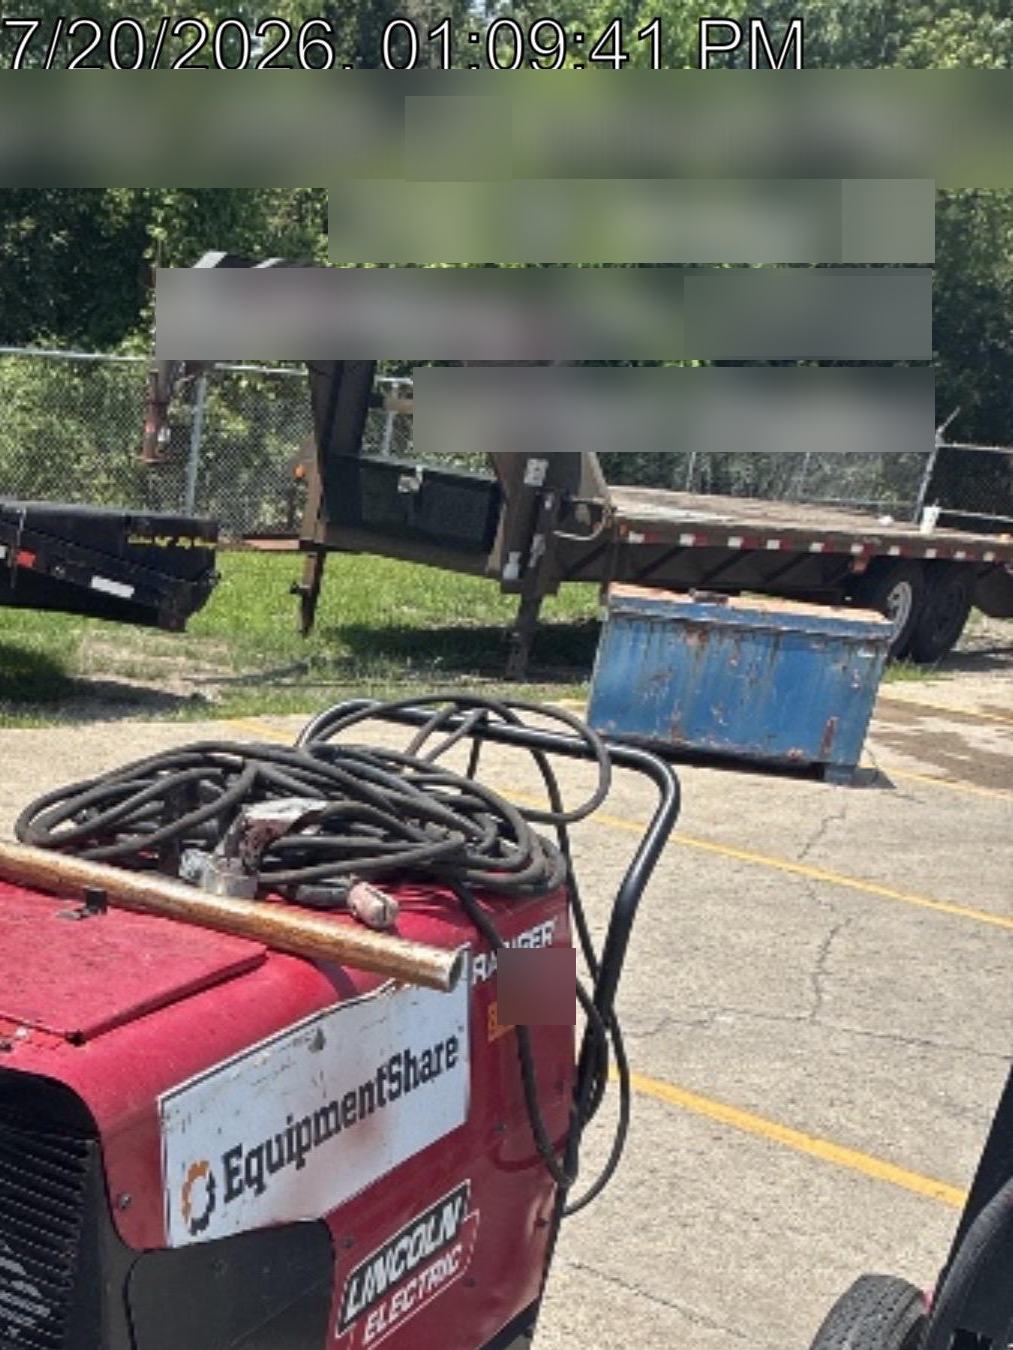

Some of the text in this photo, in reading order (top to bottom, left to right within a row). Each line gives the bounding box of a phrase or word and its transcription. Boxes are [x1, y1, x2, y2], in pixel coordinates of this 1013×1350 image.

[472, 917, 556, 984] RGER
[222, 1034, 460, 1204] EquipmentShare
[344, 1196, 463, 1324] LINCOLN
[362, 1242, 463, 1345] ELECTRIC
